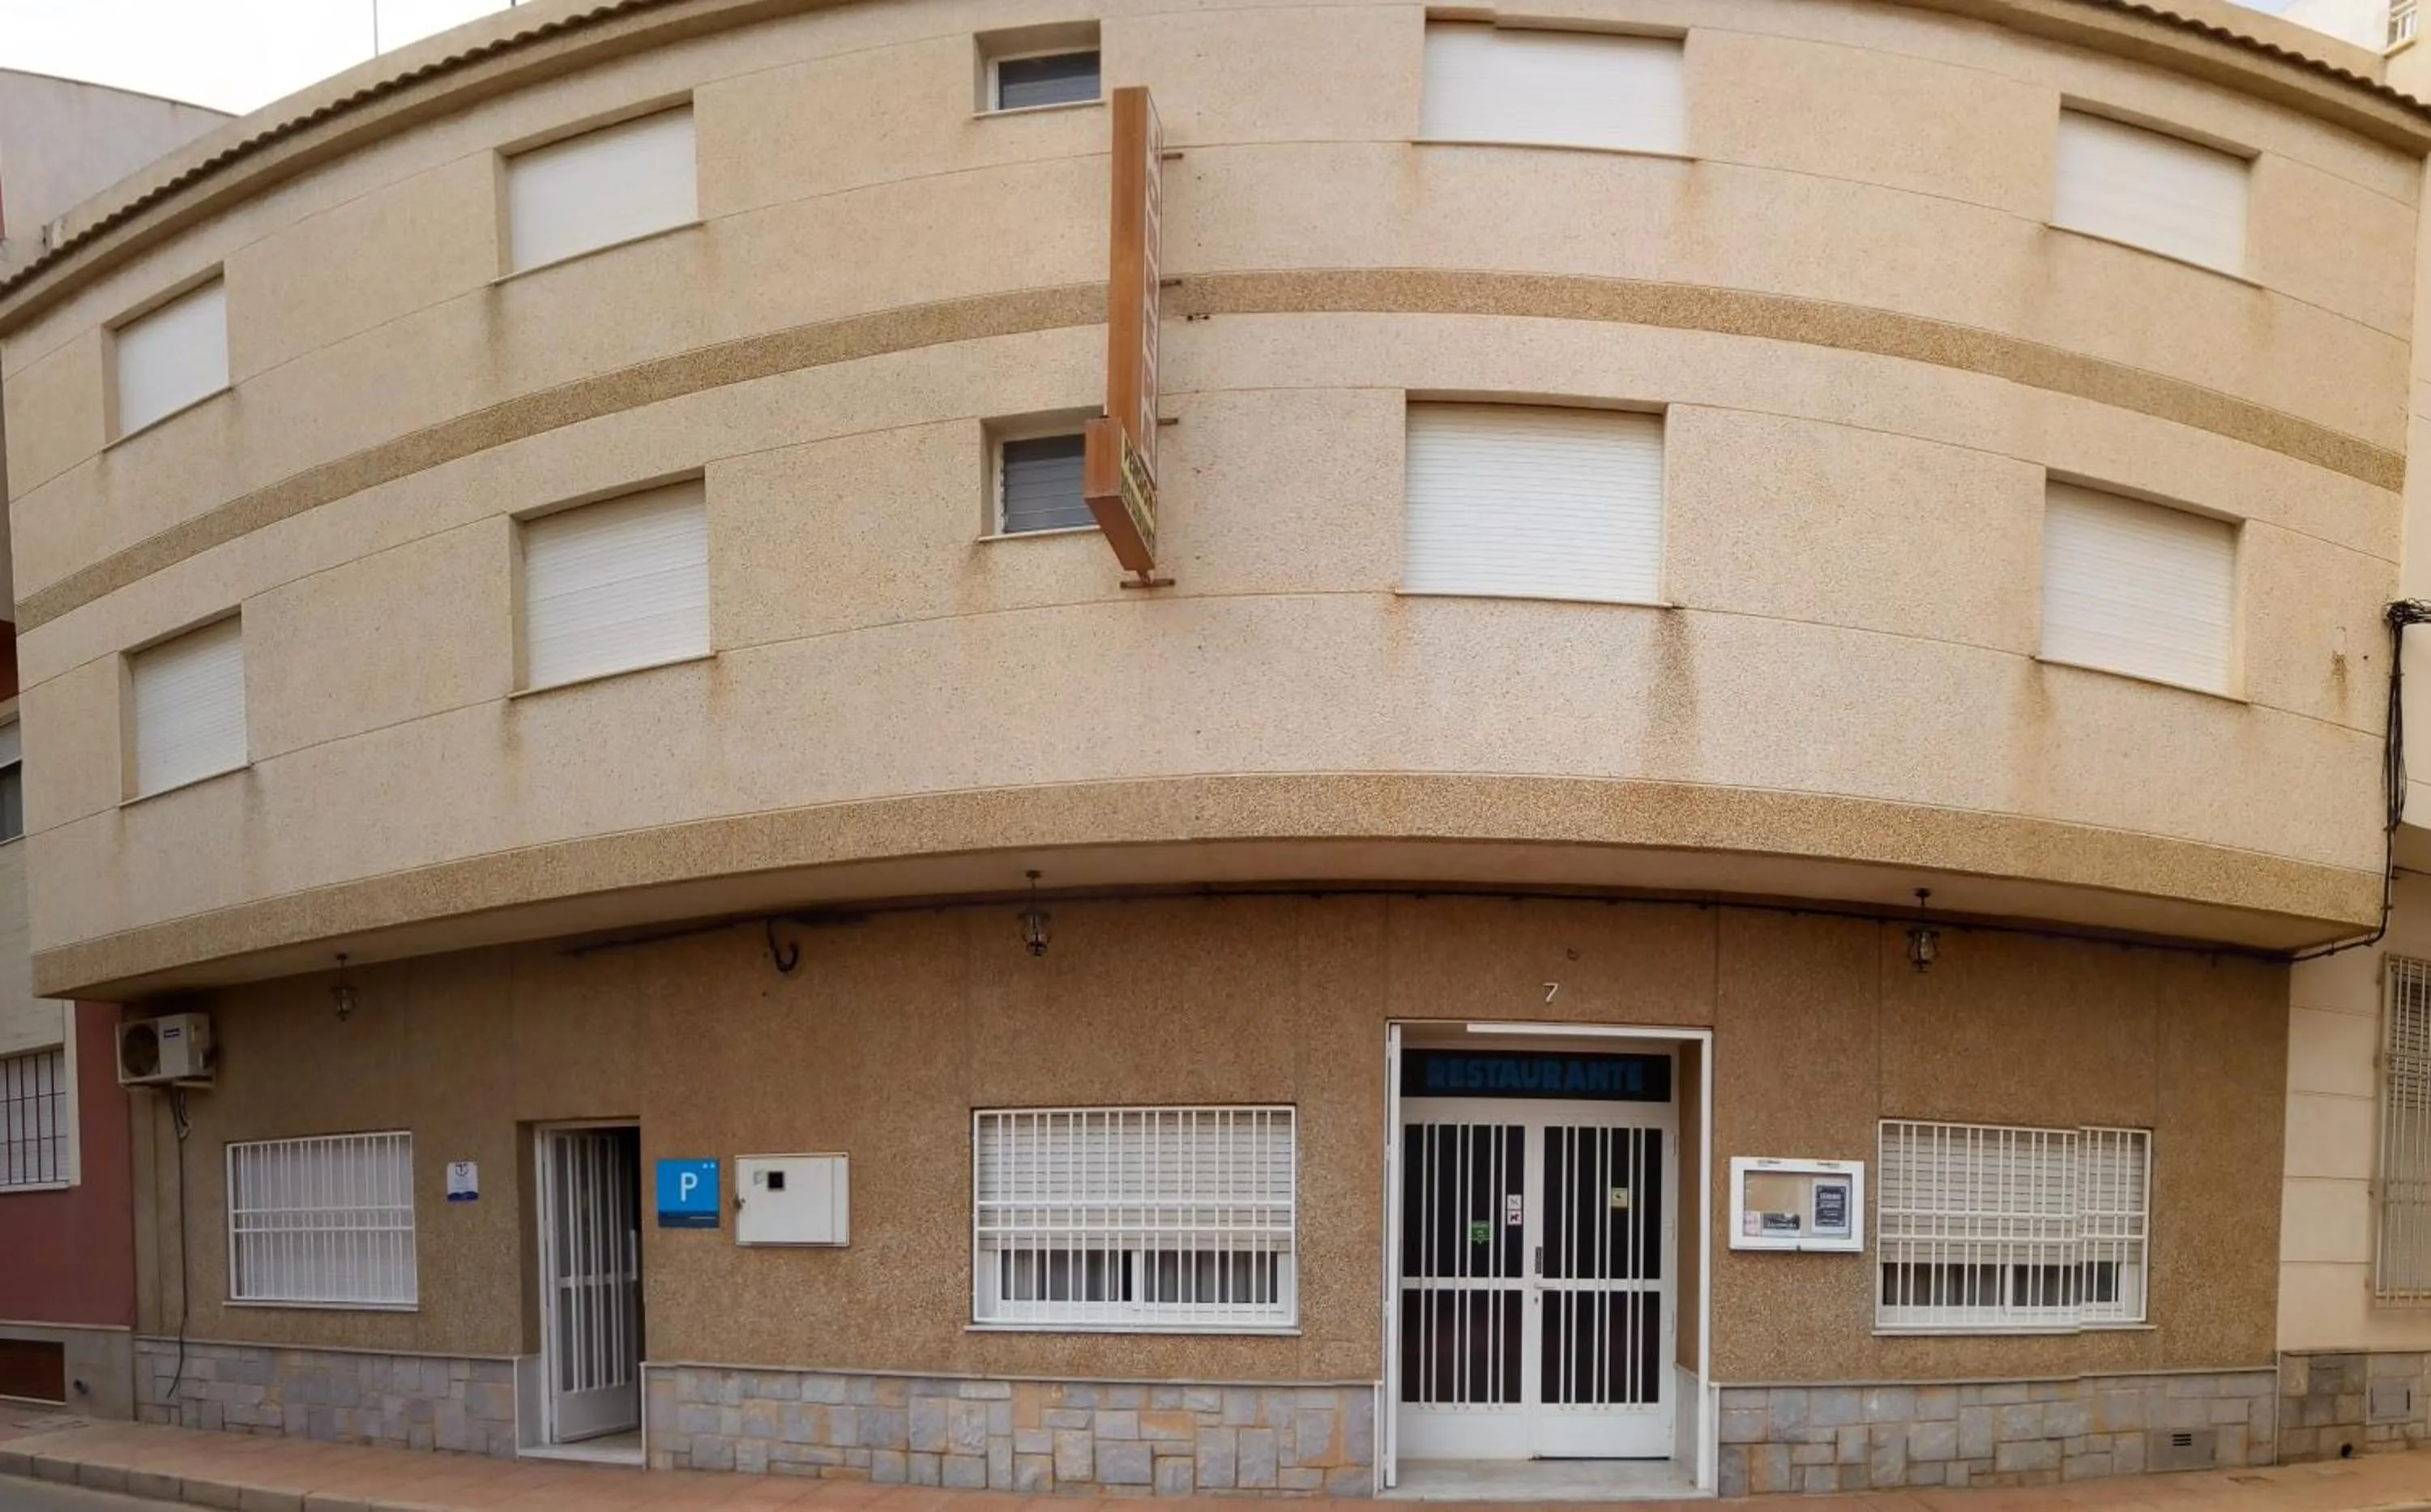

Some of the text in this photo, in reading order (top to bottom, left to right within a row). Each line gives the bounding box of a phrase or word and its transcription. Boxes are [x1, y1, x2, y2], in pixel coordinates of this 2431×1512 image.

[1542, 982, 1559, 1003] 7
[1426, 1057, 1644, 1091] RESTAURANTE
[681, 1172, 699, 1203] P
